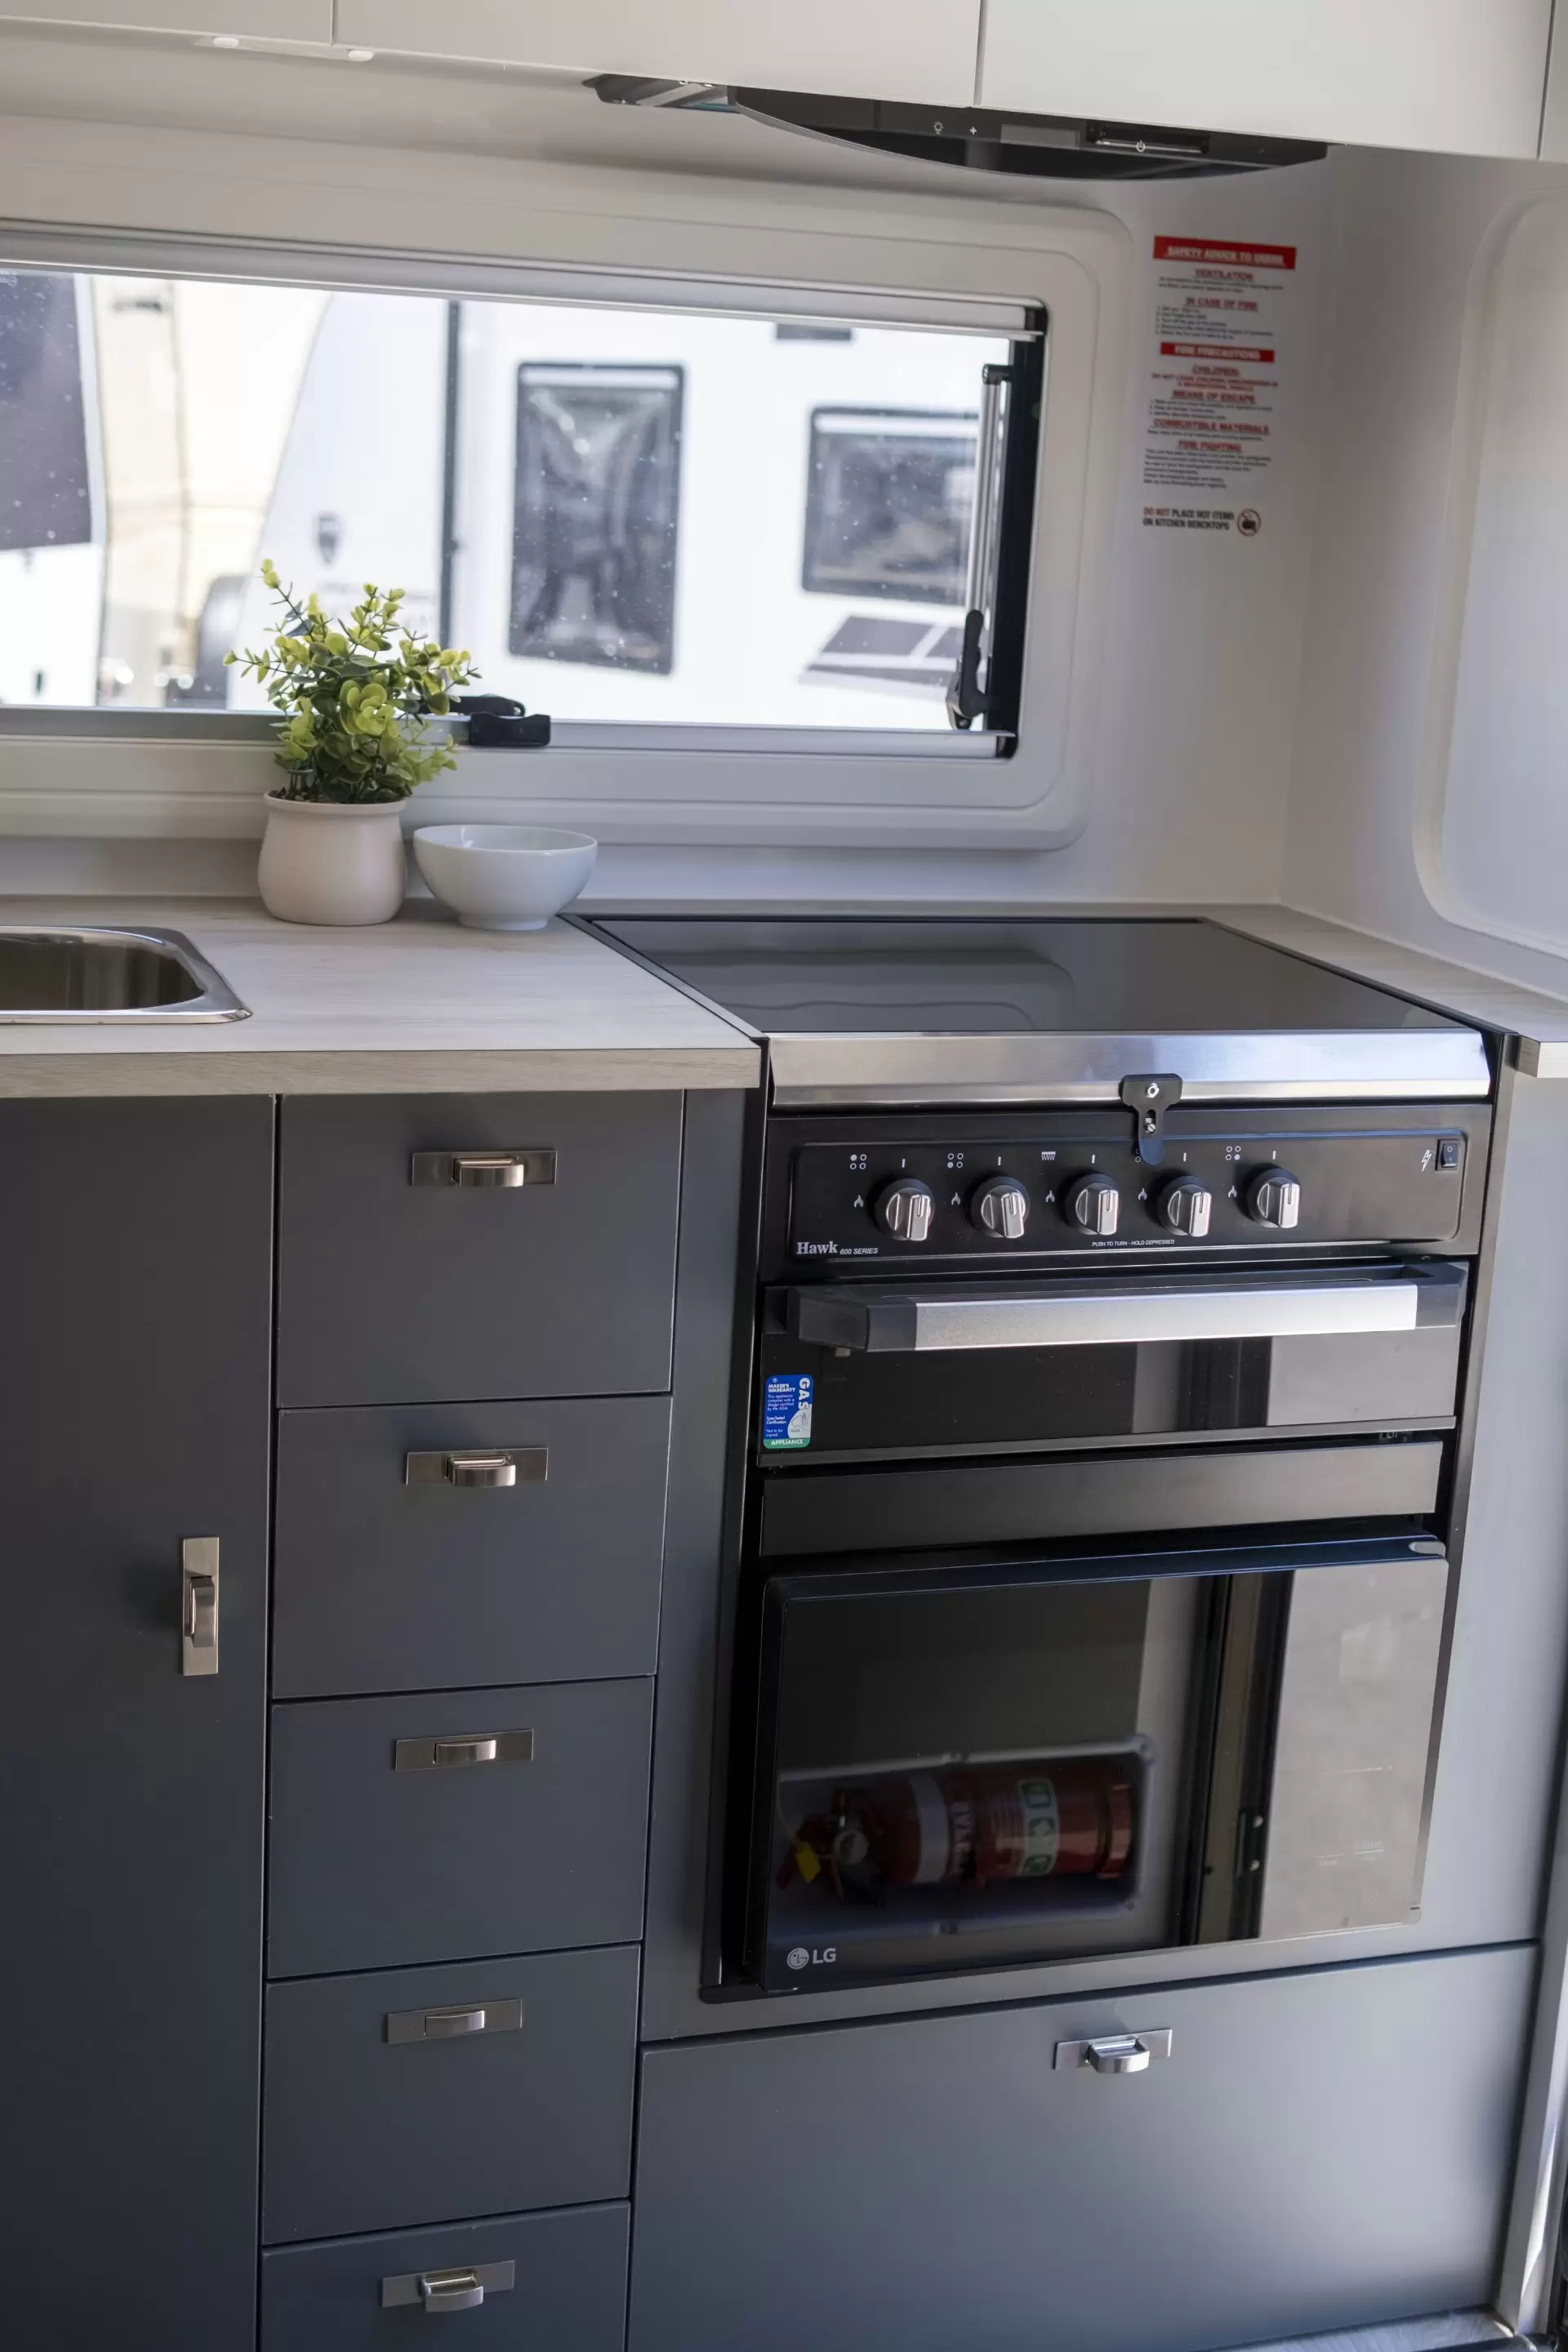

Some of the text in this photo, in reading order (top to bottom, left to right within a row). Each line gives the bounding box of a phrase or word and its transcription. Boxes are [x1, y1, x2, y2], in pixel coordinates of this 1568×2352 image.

[1172, 508, 1195, 519] PLACE
[1155, 518, 1186, 528] KITCHEN
[1187, 519, 1230, 531] BENCHTOPS
[796, 1241, 839, 1254] Hawk
[798, 1377, 811, 1410] GAS
[813, 1947, 836, 1964] LG
